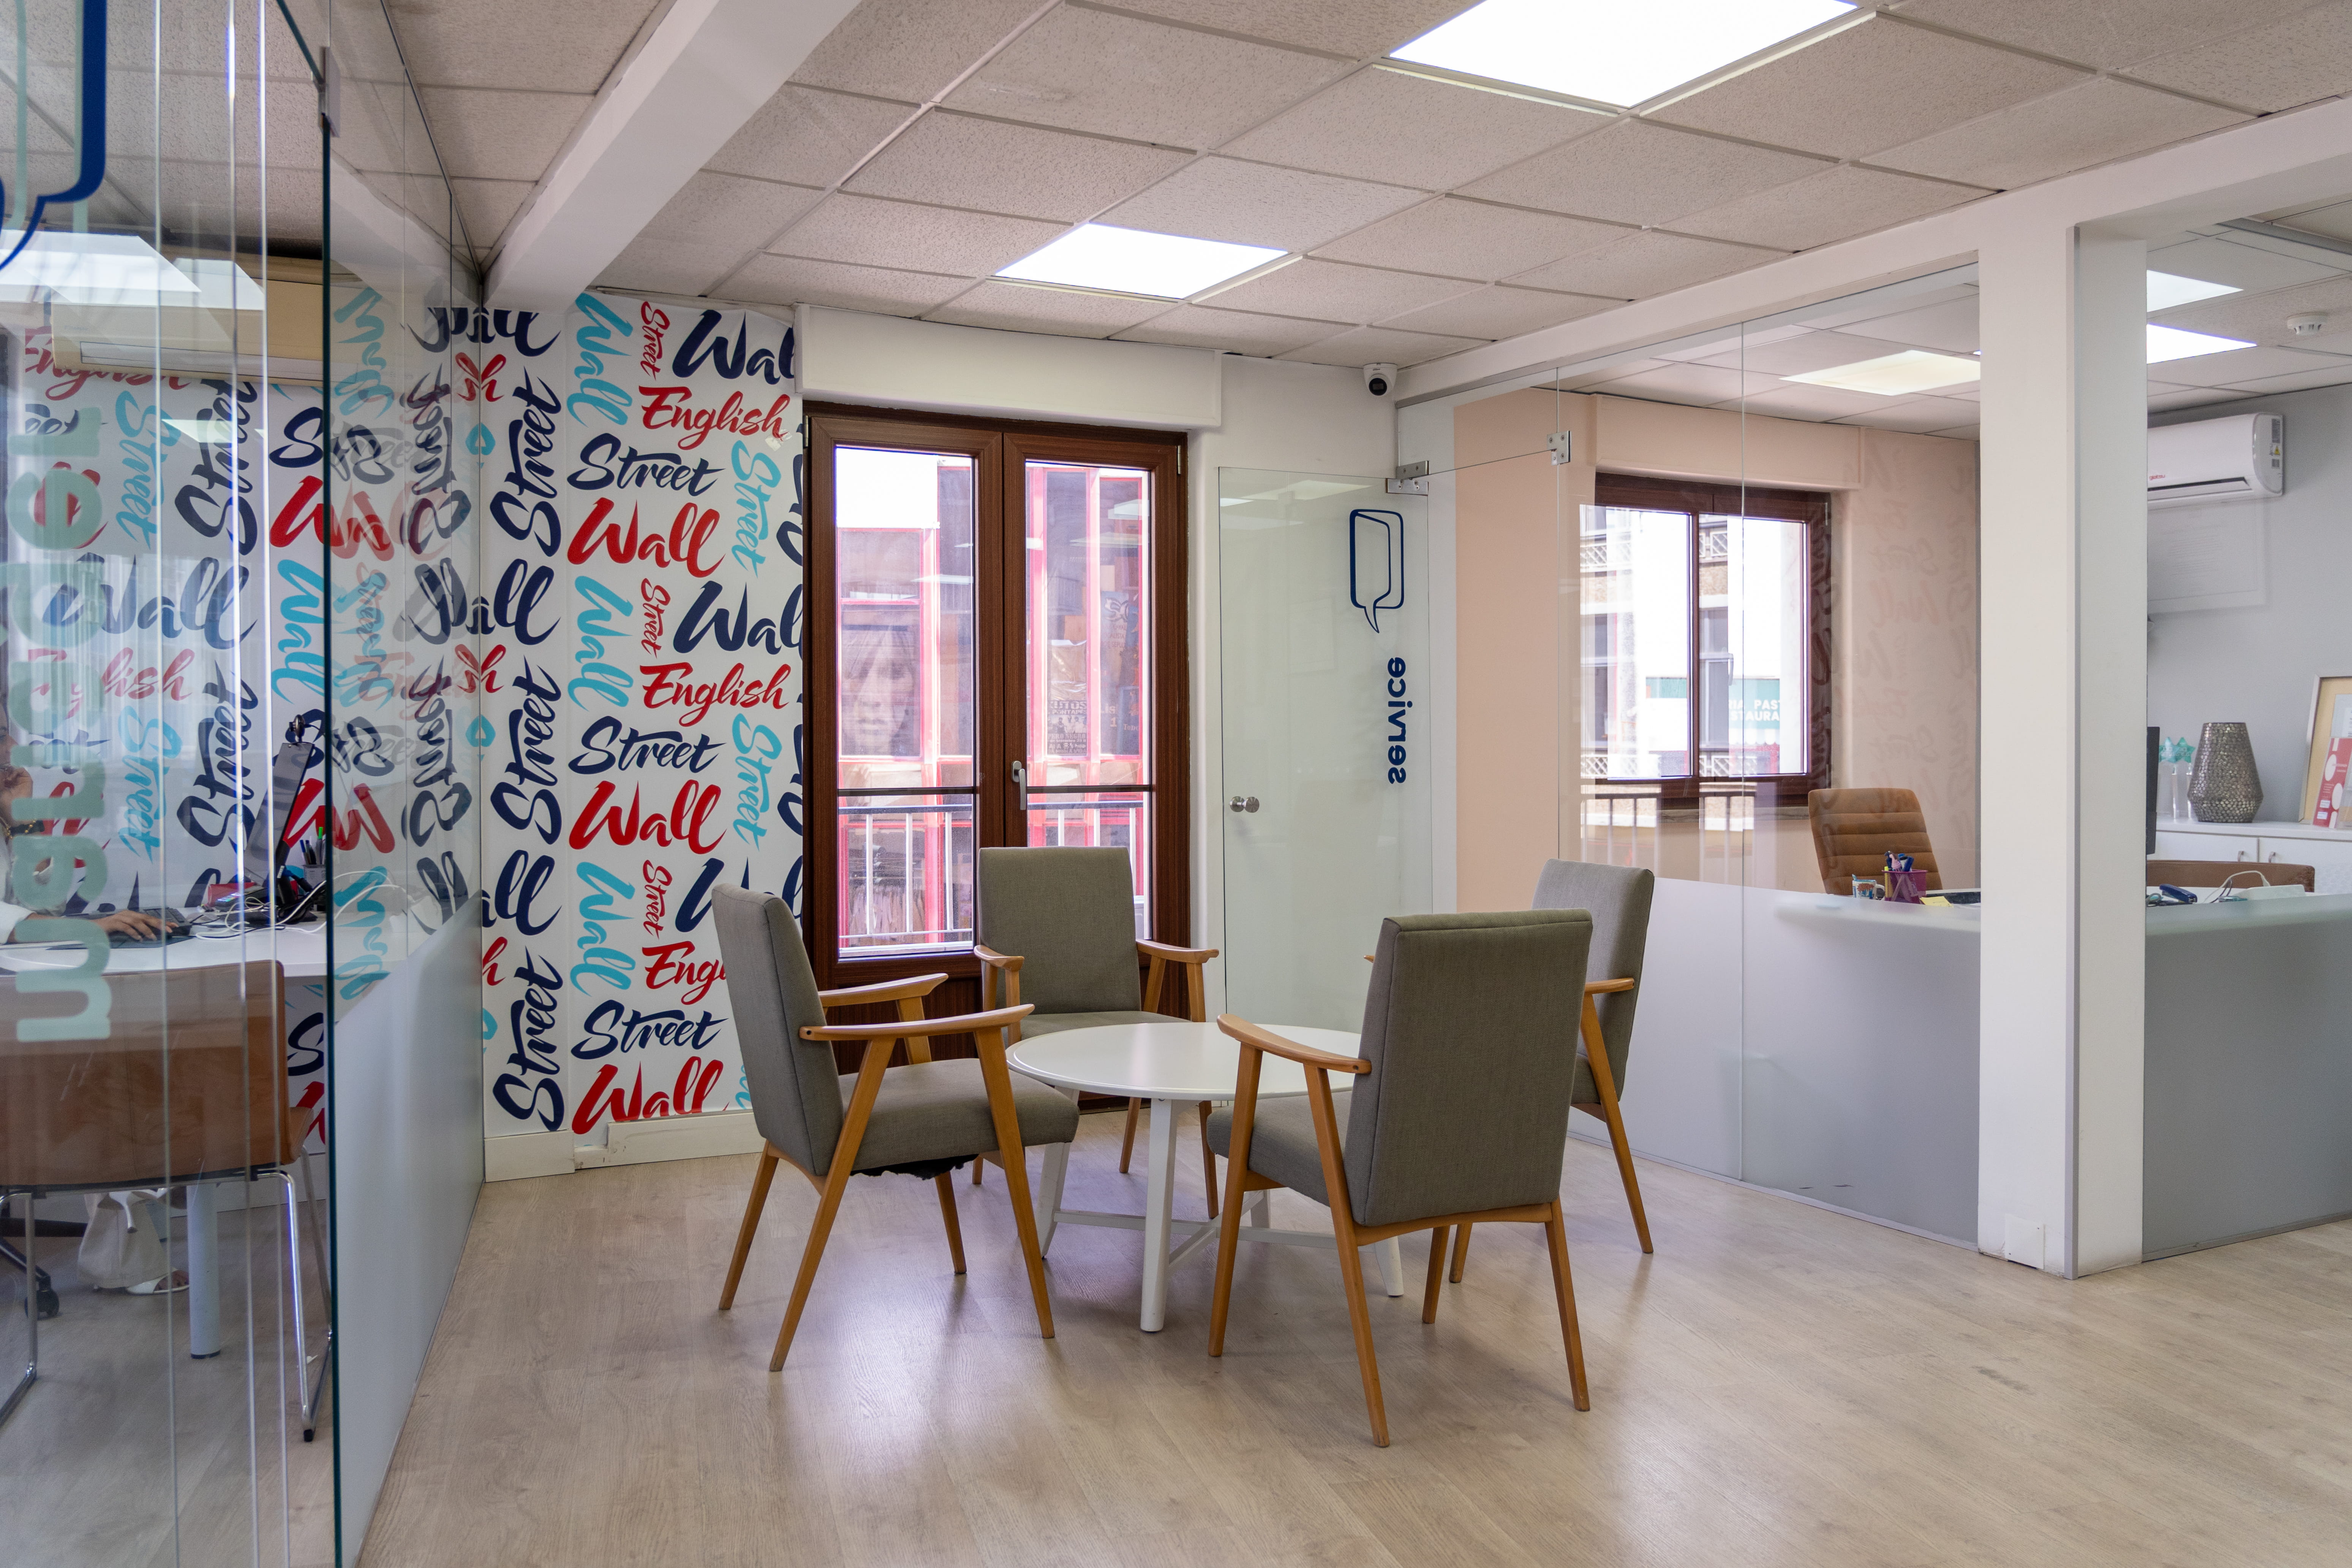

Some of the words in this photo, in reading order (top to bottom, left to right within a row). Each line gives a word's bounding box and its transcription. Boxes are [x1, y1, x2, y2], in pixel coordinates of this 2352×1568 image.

[567, 291, 633, 427] Wall
[640, 302, 670, 380] Street
[673, 310, 794, 384] Wal
[639, 386, 790, 450] English
[115, 390, 181, 550] Street
[490, 366, 561, 557] Street
[567, 433, 725, 496] Street
[567, 498, 725, 577] Wall
[732, 441, 781, 578] Street
[568, 576, 633, 711] Wall
[641, 579, 670, 658] Street
[674, 581, 802, 658] Wal
[640, 662, 790, 727] English
[118, 706, 182, 863] Street
[490, 655, 561, 844] Street
[569, 716, 726, 774] Street
[732, 713, 782, 851] Street
[569, 780, 727, 854] Wall
[570, 862, 635, 995] Wall
[643, 860, 672, 939] Street
[493, 946, 564, 1131] Street
[571, 1000, 729, 1059] Street
[572, 1056, 729, 1134] Wall
